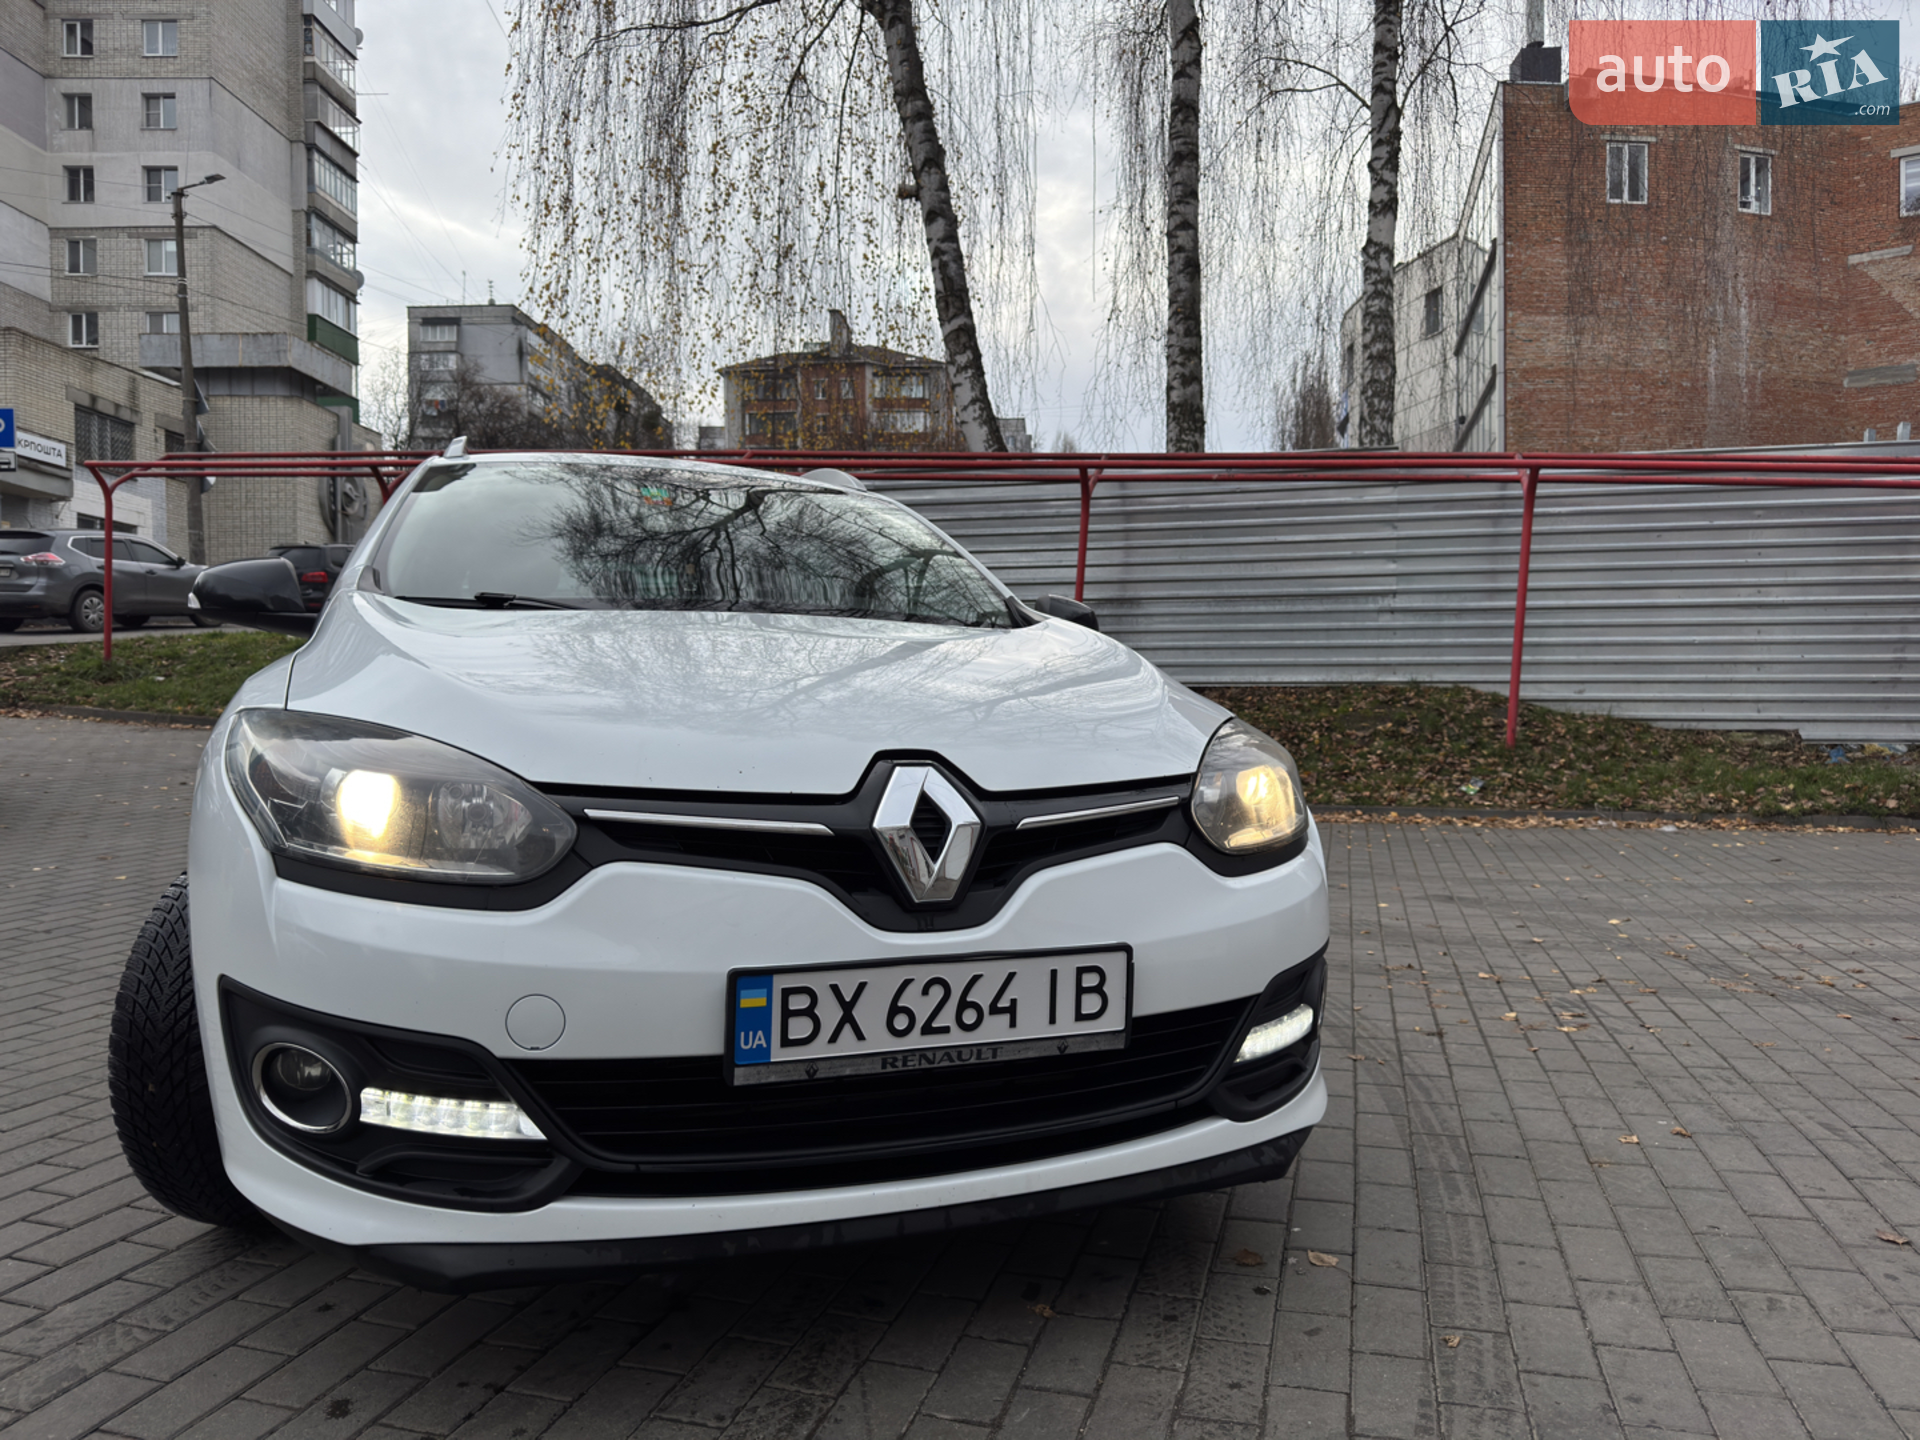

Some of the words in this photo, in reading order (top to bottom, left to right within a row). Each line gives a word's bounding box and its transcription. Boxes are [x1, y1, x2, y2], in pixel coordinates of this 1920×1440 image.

[780, 982, 868, 1048] BX
[886, 971, 1018, 1037] 6264
[1049, 965, 1109, 1025] IB
[740, 1029, 767, 1050] UA
[881, 1047, 1003, 1070] RENAULT
